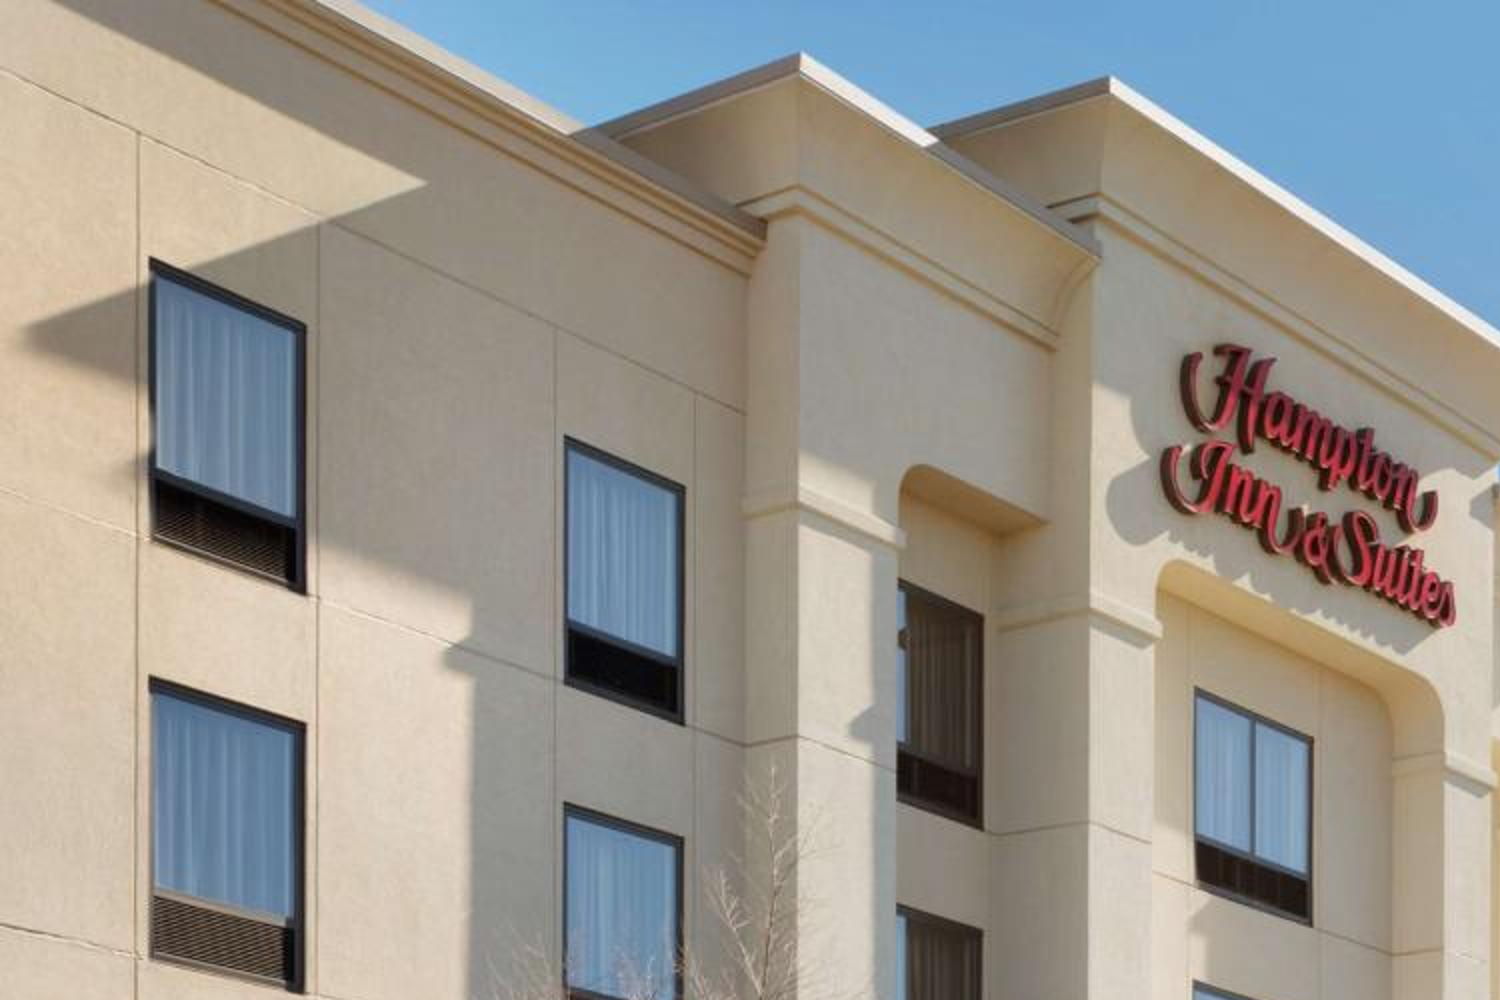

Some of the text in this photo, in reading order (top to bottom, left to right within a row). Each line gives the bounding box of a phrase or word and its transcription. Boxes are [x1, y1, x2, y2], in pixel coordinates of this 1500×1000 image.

[1180, 343, 1438, 533] Hampton
[1160, 440, 1456, 628] Inn & Suites
